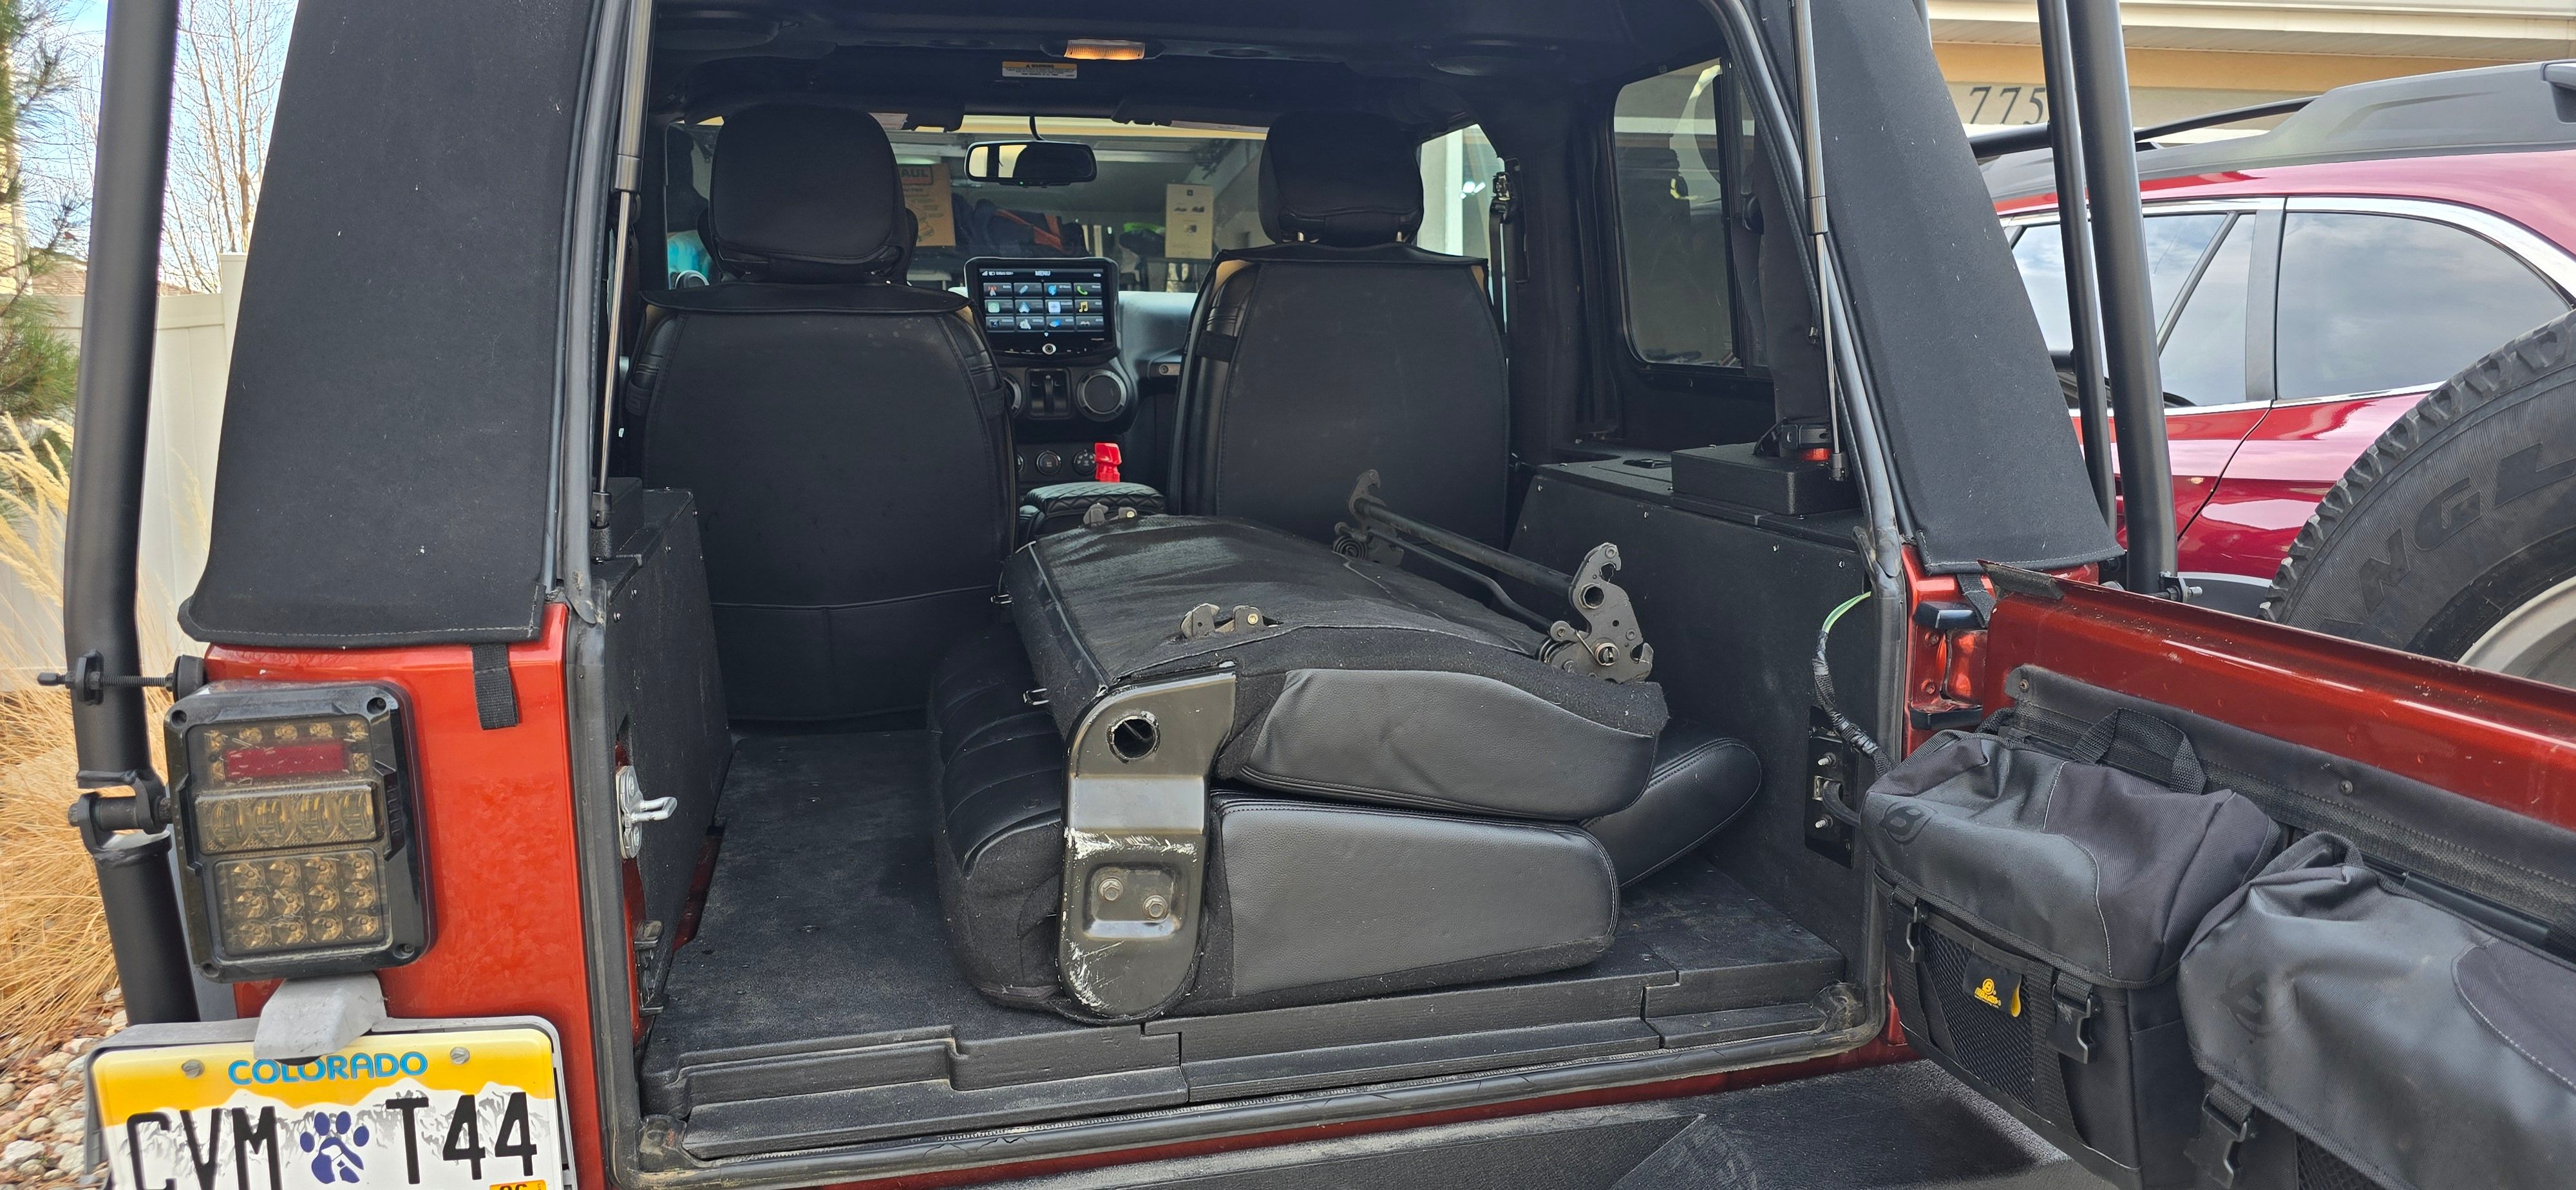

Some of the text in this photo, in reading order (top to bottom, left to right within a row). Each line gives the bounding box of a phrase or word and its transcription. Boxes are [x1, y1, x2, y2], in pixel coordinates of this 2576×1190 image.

[228, 1052, 428, 1086] COLORADO
[126, 1091, 538, 1190] CVM T44
